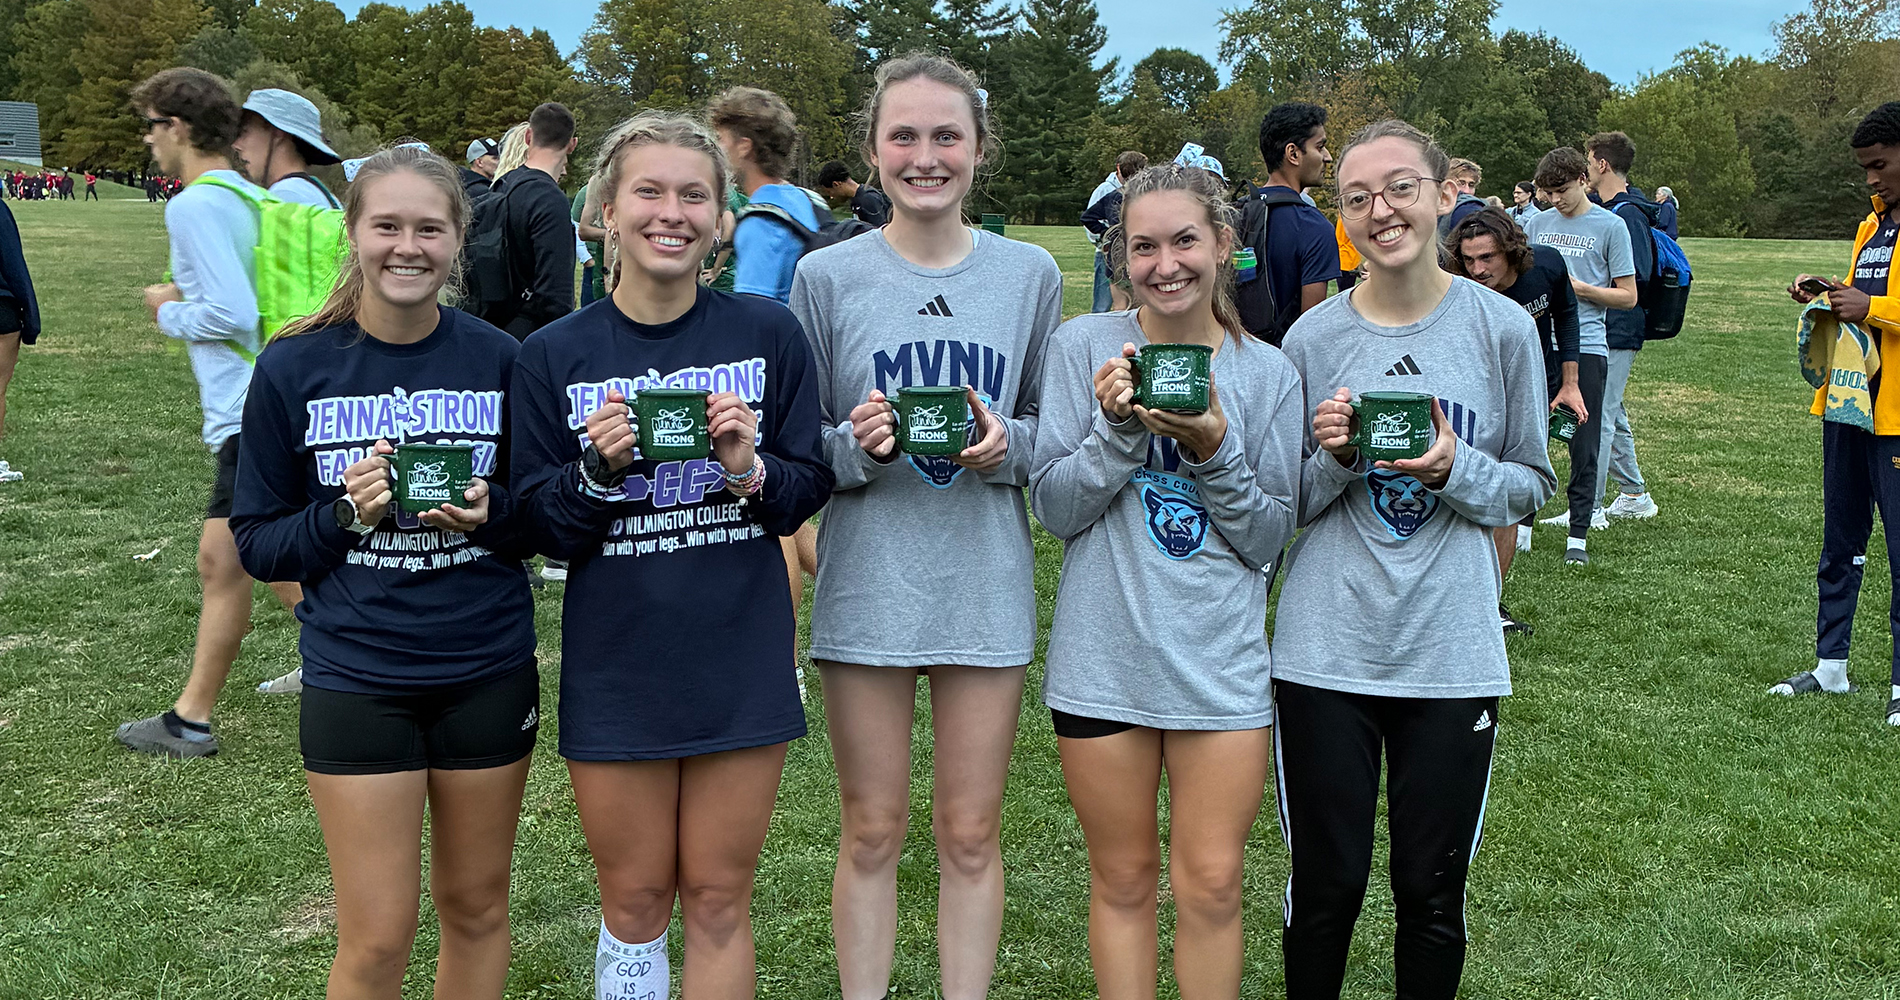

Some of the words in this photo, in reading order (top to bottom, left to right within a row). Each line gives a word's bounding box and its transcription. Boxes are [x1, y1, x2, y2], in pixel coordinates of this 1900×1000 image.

[873, 339, 1006, 402] MVNU
[1152, 383, 1190, 392] STRONG
[305, 394, 398, 446] JENNA
[408, 388, 505, 437] STRON
[653, 434, 695, 443] STRONG
[909, 430, 948, 439] STRONG
[1371, 437, 1410, 446] STRONG
[408, 488, 450, 497] STRONG
[625, 508, 694, 535] WILMINGTON
[696, 502, 742, 526] COLLEGE
[370, 531, 439, 552] WILMINGTON
[616, 539, 633, 556] with
[635, 540, 657, 558] your
[706, 526, 727, 545] with
[728, 526, 750, 544] your
[378, 554, 403, 570] your
[452, 547, 472, 565] with
[616, 961, 652, 978] GOD
[623, 982, 636, 995] IS
